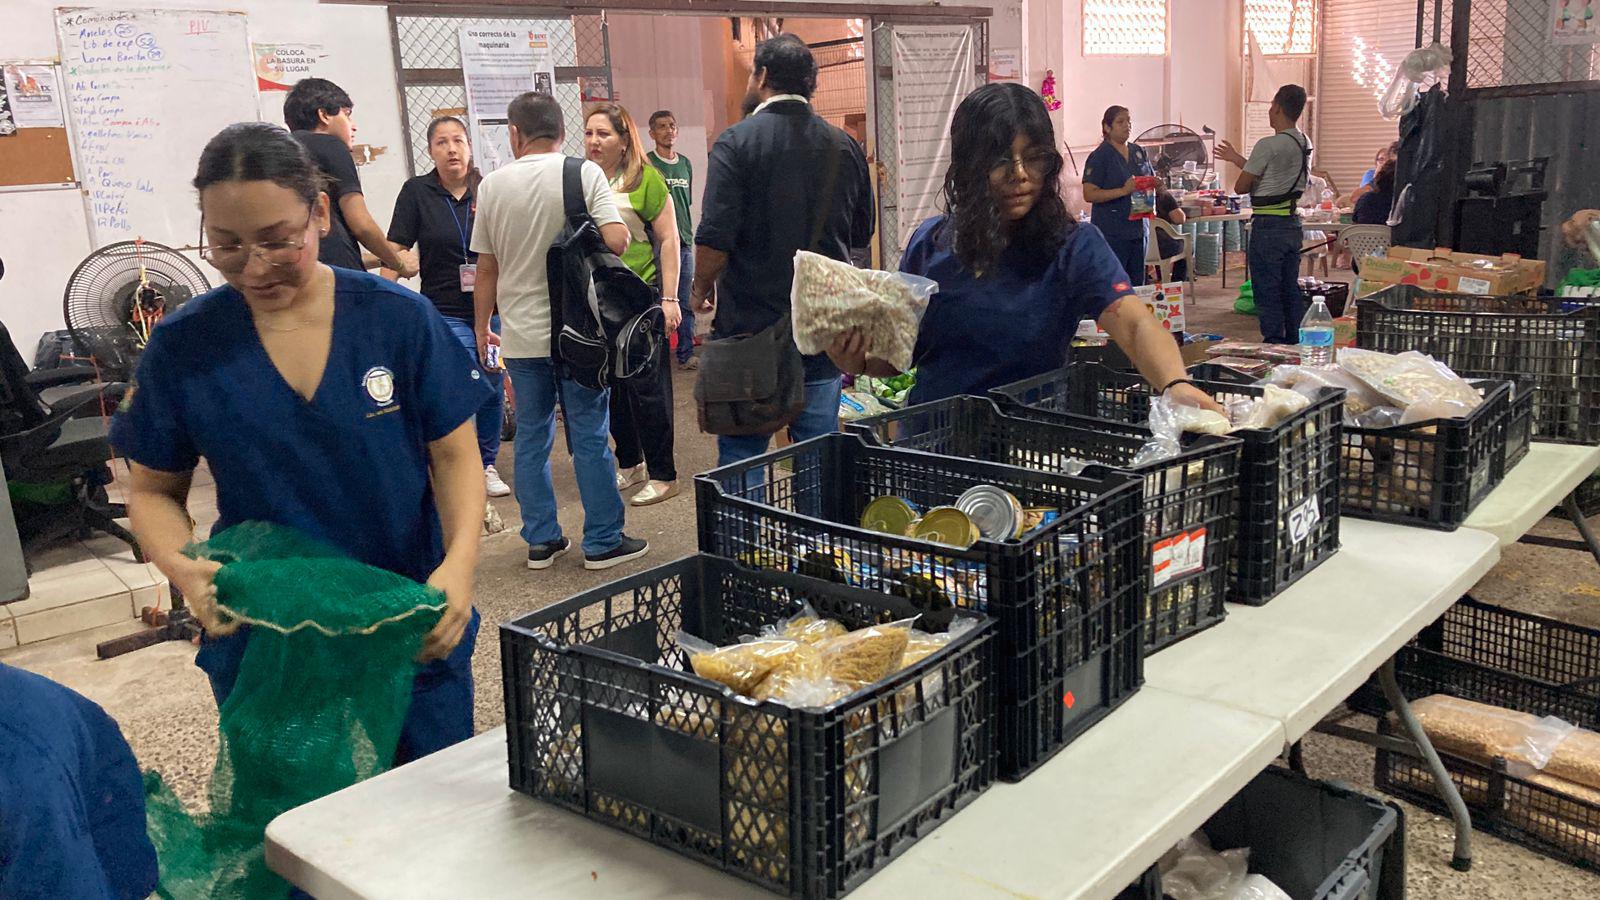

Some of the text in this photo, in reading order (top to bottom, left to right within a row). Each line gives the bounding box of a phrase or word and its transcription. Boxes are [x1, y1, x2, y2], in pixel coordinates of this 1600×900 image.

[503, 30, 511, 38] de
[511, 30, 517, 38] la
[478, 42, 510, 50] maquinaria
[82, 52, 112, 63] Loma
